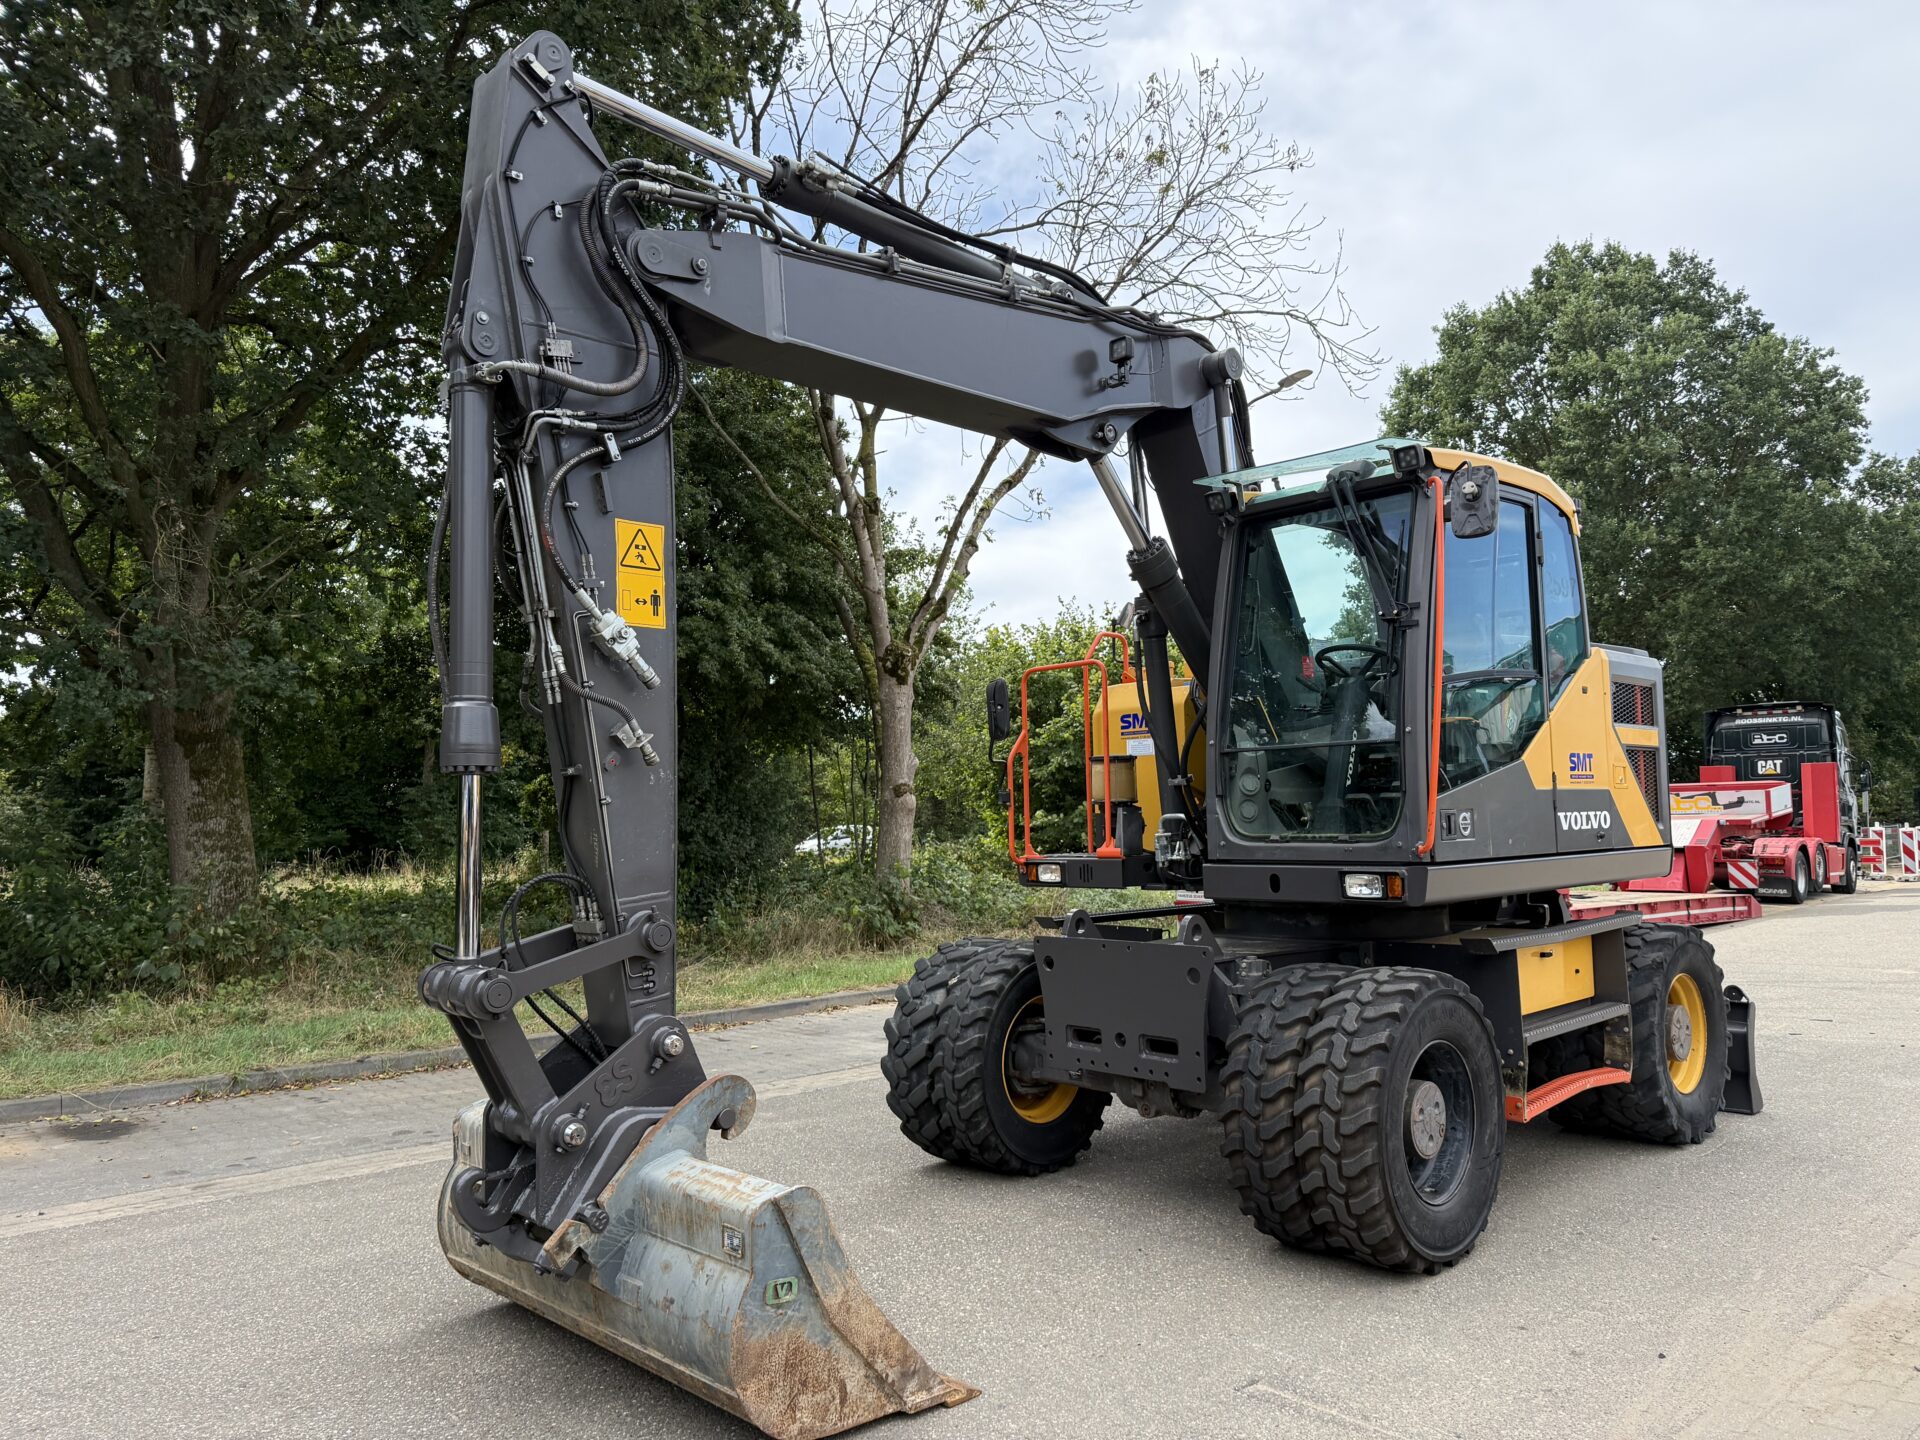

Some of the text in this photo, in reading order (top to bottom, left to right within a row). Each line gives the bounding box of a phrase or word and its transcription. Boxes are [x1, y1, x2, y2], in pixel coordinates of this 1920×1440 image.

[612, 244, 630, 276] VOLVO
[580, 446, 605, 458] VOLVO
[1120, 713, 1147, 730] SM
[1569, 753, 1593, 772] SMT
[1757, 760, 1783, 774] CAT
[1557, 811, 1611, 831] VOLVO
